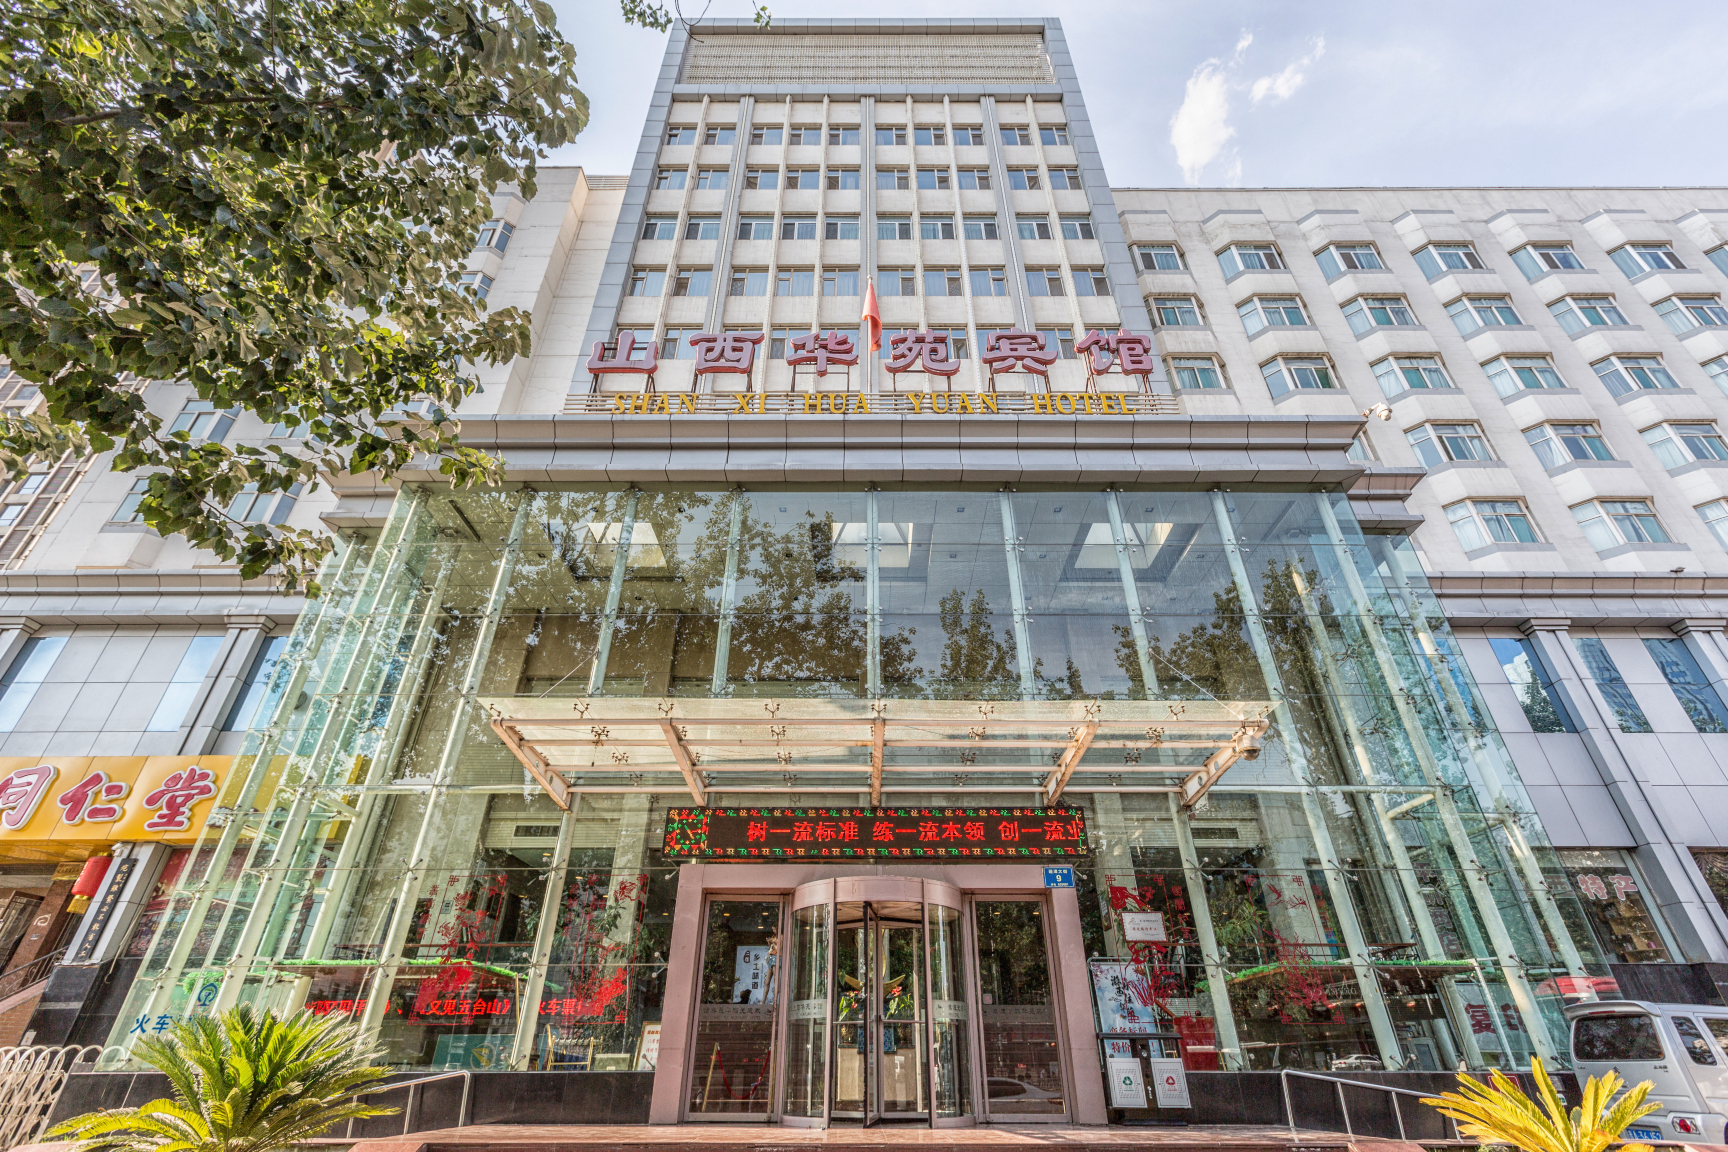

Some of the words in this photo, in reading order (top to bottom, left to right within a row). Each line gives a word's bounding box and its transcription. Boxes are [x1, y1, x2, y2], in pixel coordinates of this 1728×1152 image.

[585, 327, 1153, 377] 山西华苑宾馆
[611, 393, 699, 414] SHAN
[732, 393, 768, 414] XI
[802, 393, 872, 414] HUA
[906, 393, 998, 414] YUAN
[1031, 393, 1137, 414] HOTEL
[747, 820, 860, 842] 树一流标准
[872, 820, 986, 842] 练一流本领
[1055, 874, 1063, 883] 9
[1465, 1002, 1528, 1035] 复印
